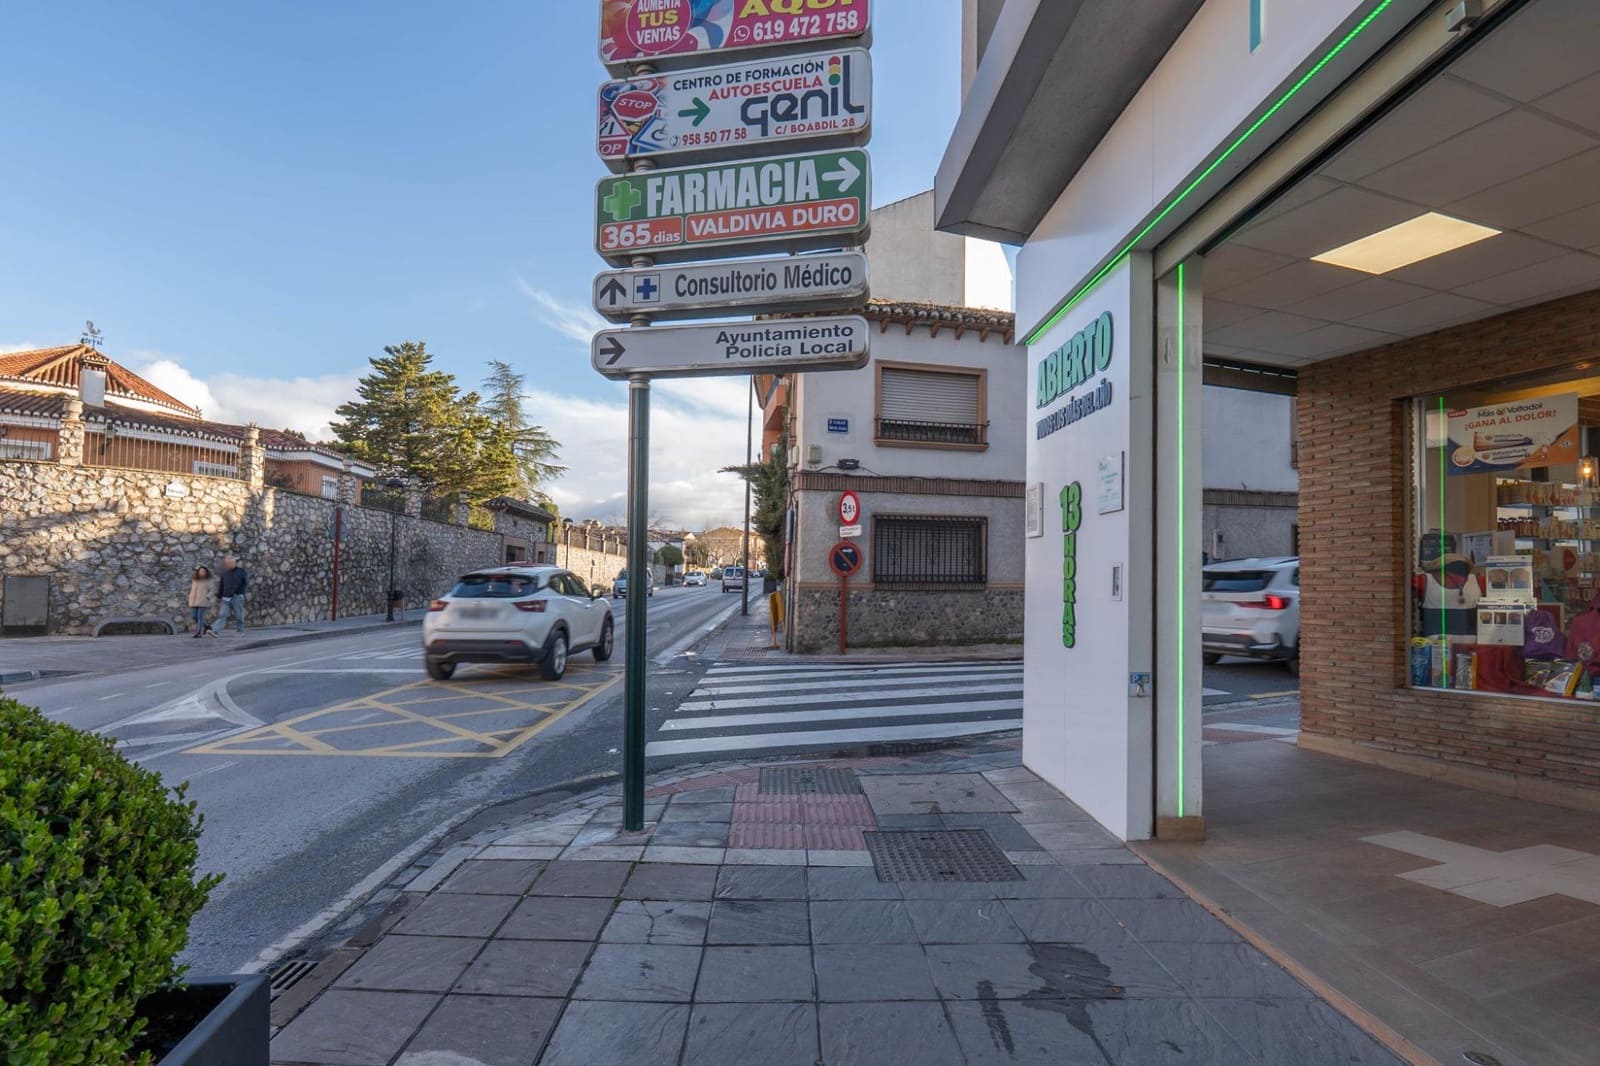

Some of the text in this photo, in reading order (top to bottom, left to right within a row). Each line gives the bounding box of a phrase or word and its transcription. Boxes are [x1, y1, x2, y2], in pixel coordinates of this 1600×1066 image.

[638, 10, 679, 28] TUS
[738, 0, 853, 18] AQ
[636, 26, 681, 45] VENTAS
[752, 10, 858, 41] 619 472 758
[673, 59, 824, 91] CENTRO DE FORMACIÓN
[708, 75, 823, 101] AUTOESCUELA
[619, 98, 652, 110] STOP
[682, 127, 747, 146] 958 50 77 58
[775, 117, 855, 135] C/ BOABDIL 28
[647, 159, 820, 217] FARMACIA
[690, 203, 855, 236] VALDIVIA DURO
[604, 223, 650, 249] 365
[675, 263, 852, 297] Consultorio Médico
[716, 324, 853, 346] Ayuntamiento
[726, 340, 853, 359] Policía Local
[1036, 310, 1114, 409] ABIERTO
[1464, 409, 1557, 431] ¡GANA AL DOLOR!
[1060, 481, 1082, 648] 13 HORAS
